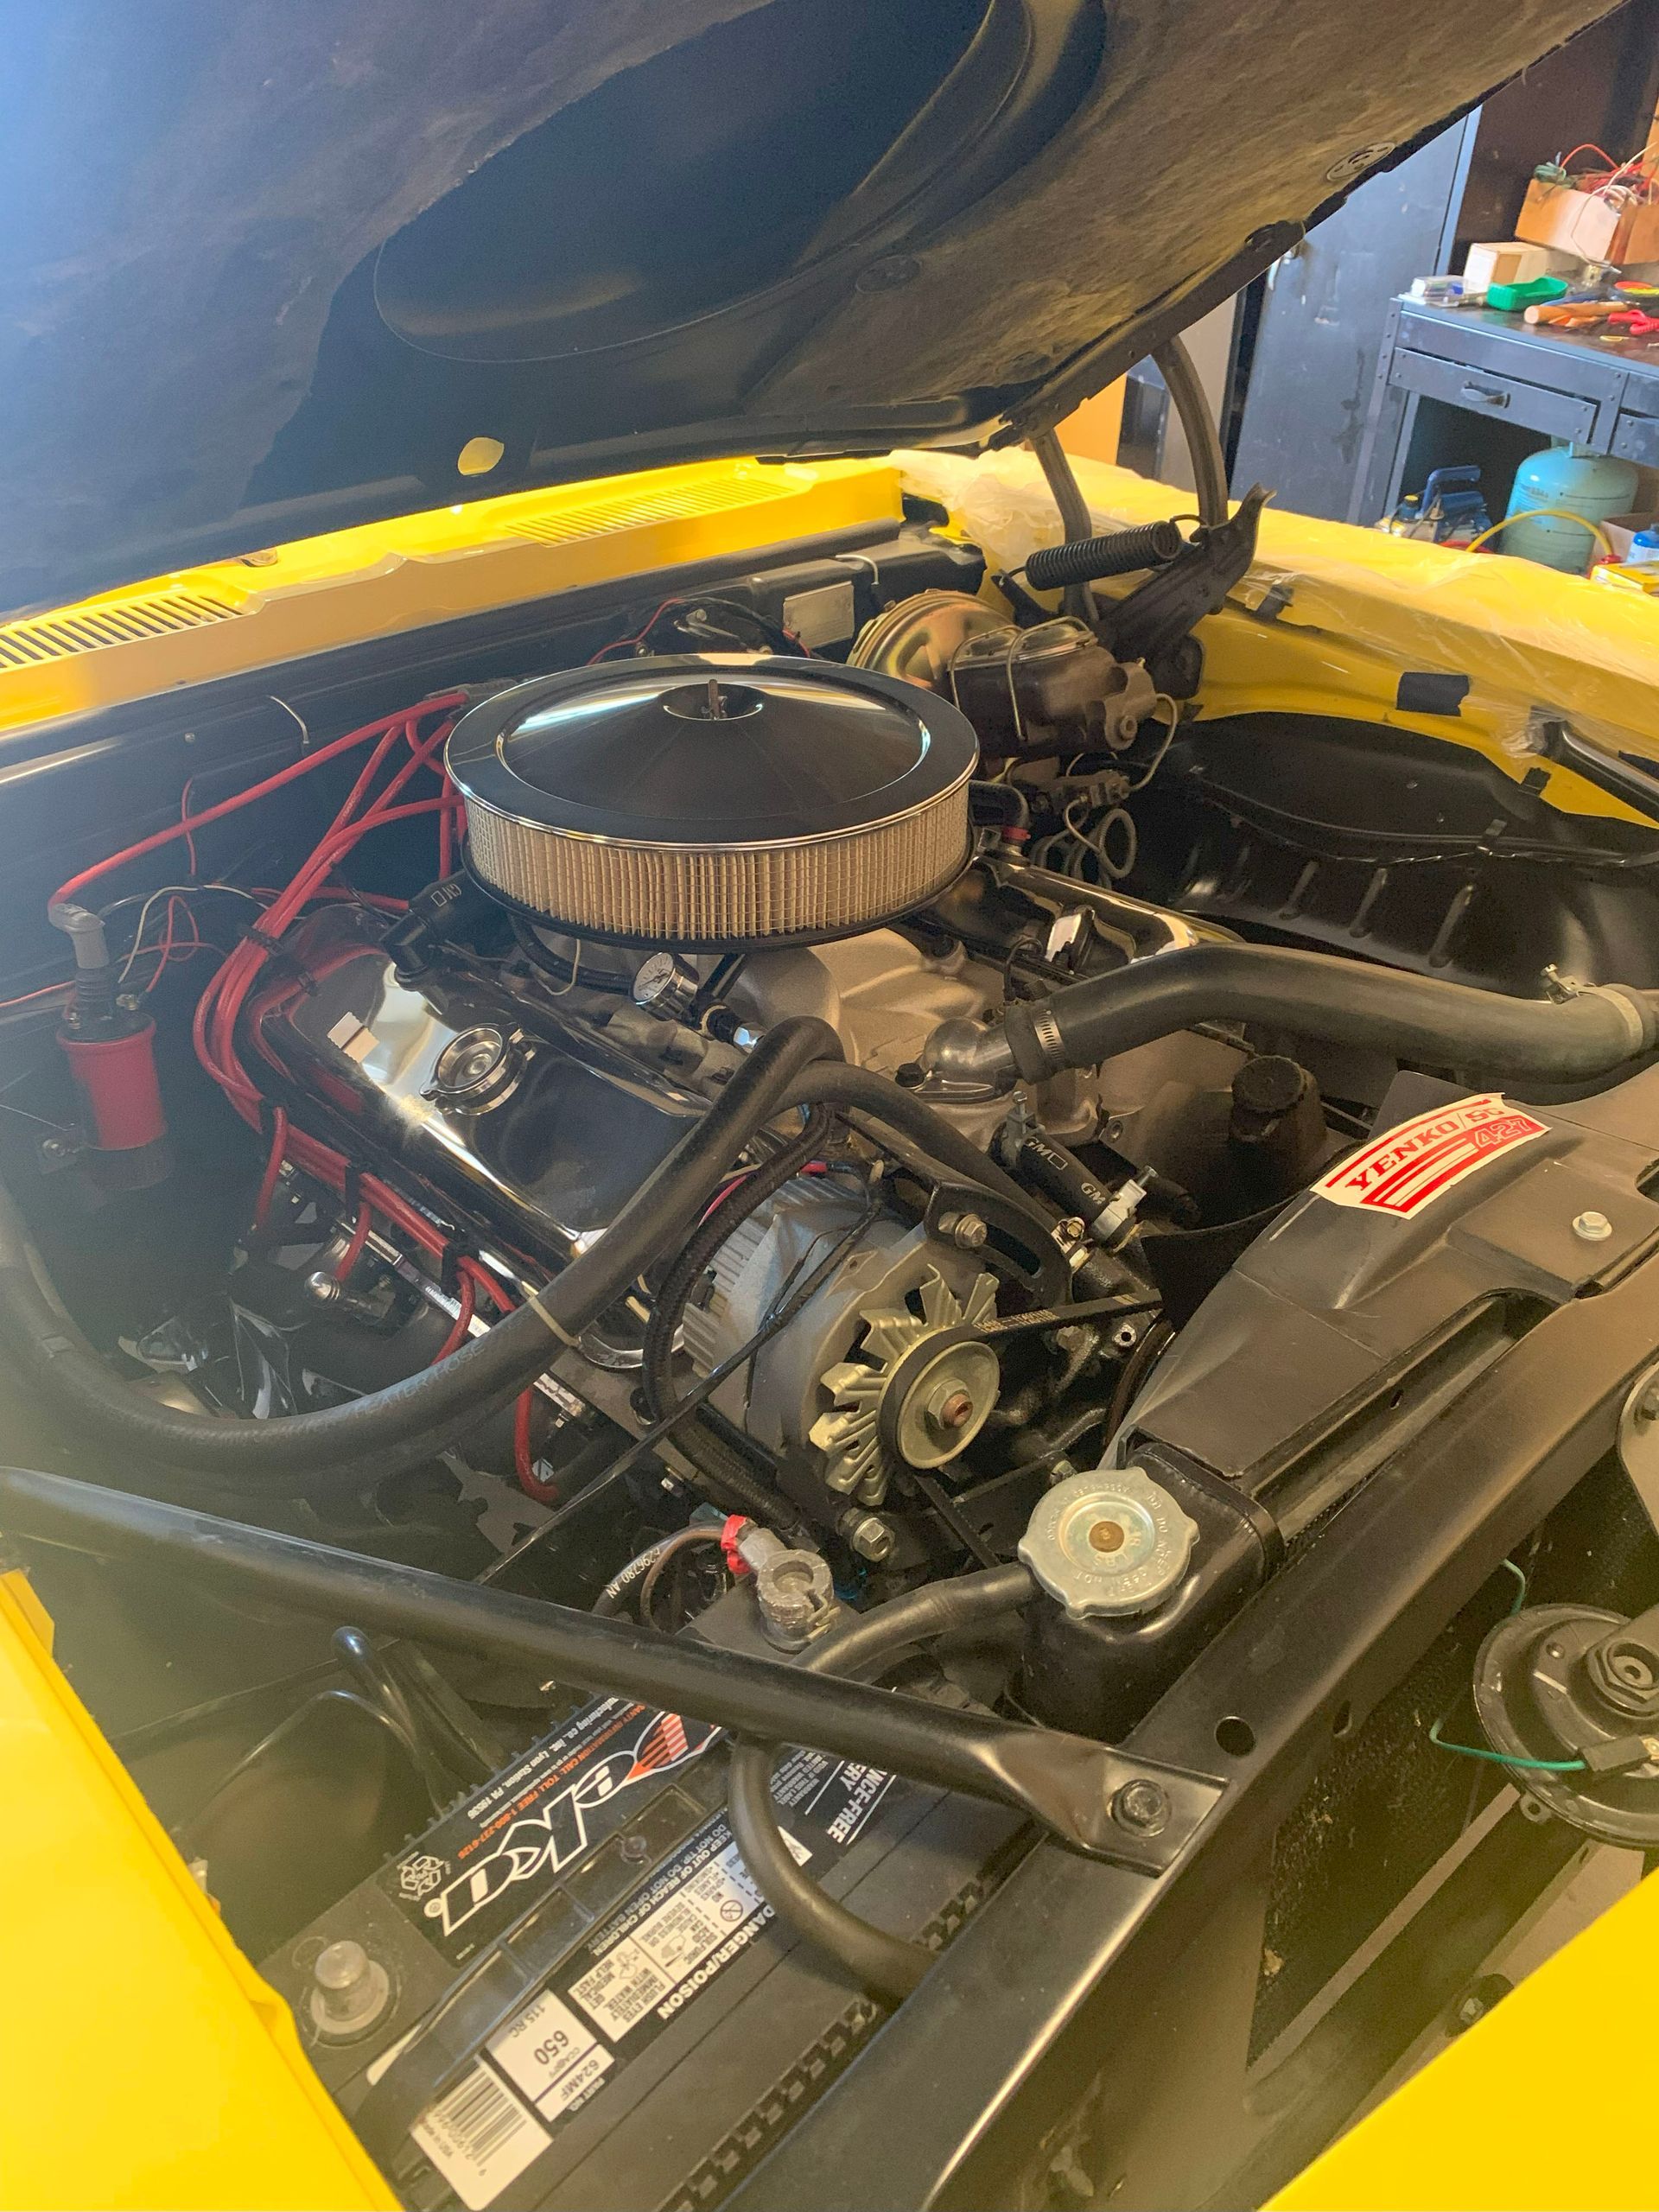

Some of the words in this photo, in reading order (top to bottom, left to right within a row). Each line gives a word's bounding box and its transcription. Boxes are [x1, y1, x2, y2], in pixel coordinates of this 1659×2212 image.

[1473, 1114, 1535, 1149] 427
[530, 1750, 548, 1768] Lyon
[812, 1759, 828, 1774] VOID
[490, 1786, 504, 1800] PA
[538, 1773, 558, 1793] TOLL
[772, 1771, 803, 1800] WARRANTY
[794, 1777, 808, 1790] THIS
[467, 1796, 491, 1819] 19536
[517, 1789, 538, 1810] FREE
[777, 1788, 796, 1807] LABEL
[828, 1769, 885, 1840] NCE-FREE
[711, 1822, 726, 1837] DO
[694, 1834, 712, 1853] NOT
[709, 1829, 731, 1852] KEEP
[691, 1849, 709, 1867] OUT
[666, 1863, 681, 1878] DO
[678, 1864, 693, 1878] OF
[649, 1874, 668, 1893] NOT
[649, 1876, 679, 1904] REACH
[624, 1891, 649, 1916] OPEN
[711, 1891, 723, 1903] NO
[636, 1902, 651, 1916] OF
[662, 1902, 683, 1923] SEVERE
[659, 1908, 690, 1936] BLINDNESS
[677, 1913, 696, 1932] CAUSE
[689, 1919, 702, 1932] CAN
[592, 1914, 637, 1957] CHILDREN.
[648, 1936, 658, 1947] OR
[692, 1925, 709, 1942] ACID
[683, 1933, 715, 1963] SULFURIC
[594, 1960, 613, 1978] HELP
[658, 1905, 773, 2018] DANGER/POISON
[574, 1976, 594, 1996] FAST.
[582, 1971, 613, 2003] MEDICAL
[631, 1968, 650, 1986] WITH
[588, 1993, 605, 2010] GET
[603, 1985, 632, 2012] WATER.
[610, 1975, 657, 2019] IMMEDIATELY
[641, 1982, 664, 2004] FLUSH
[524, 2003, 544, 2024] 115
[623, 2003, 642, 2021] EYES
[508, 2019, 526, 2038] RC
[533, 2030, 569, 2065] 650
[558, 2060, 598, 2099] 624MF
[582, 2077, 604, 2098] PART
